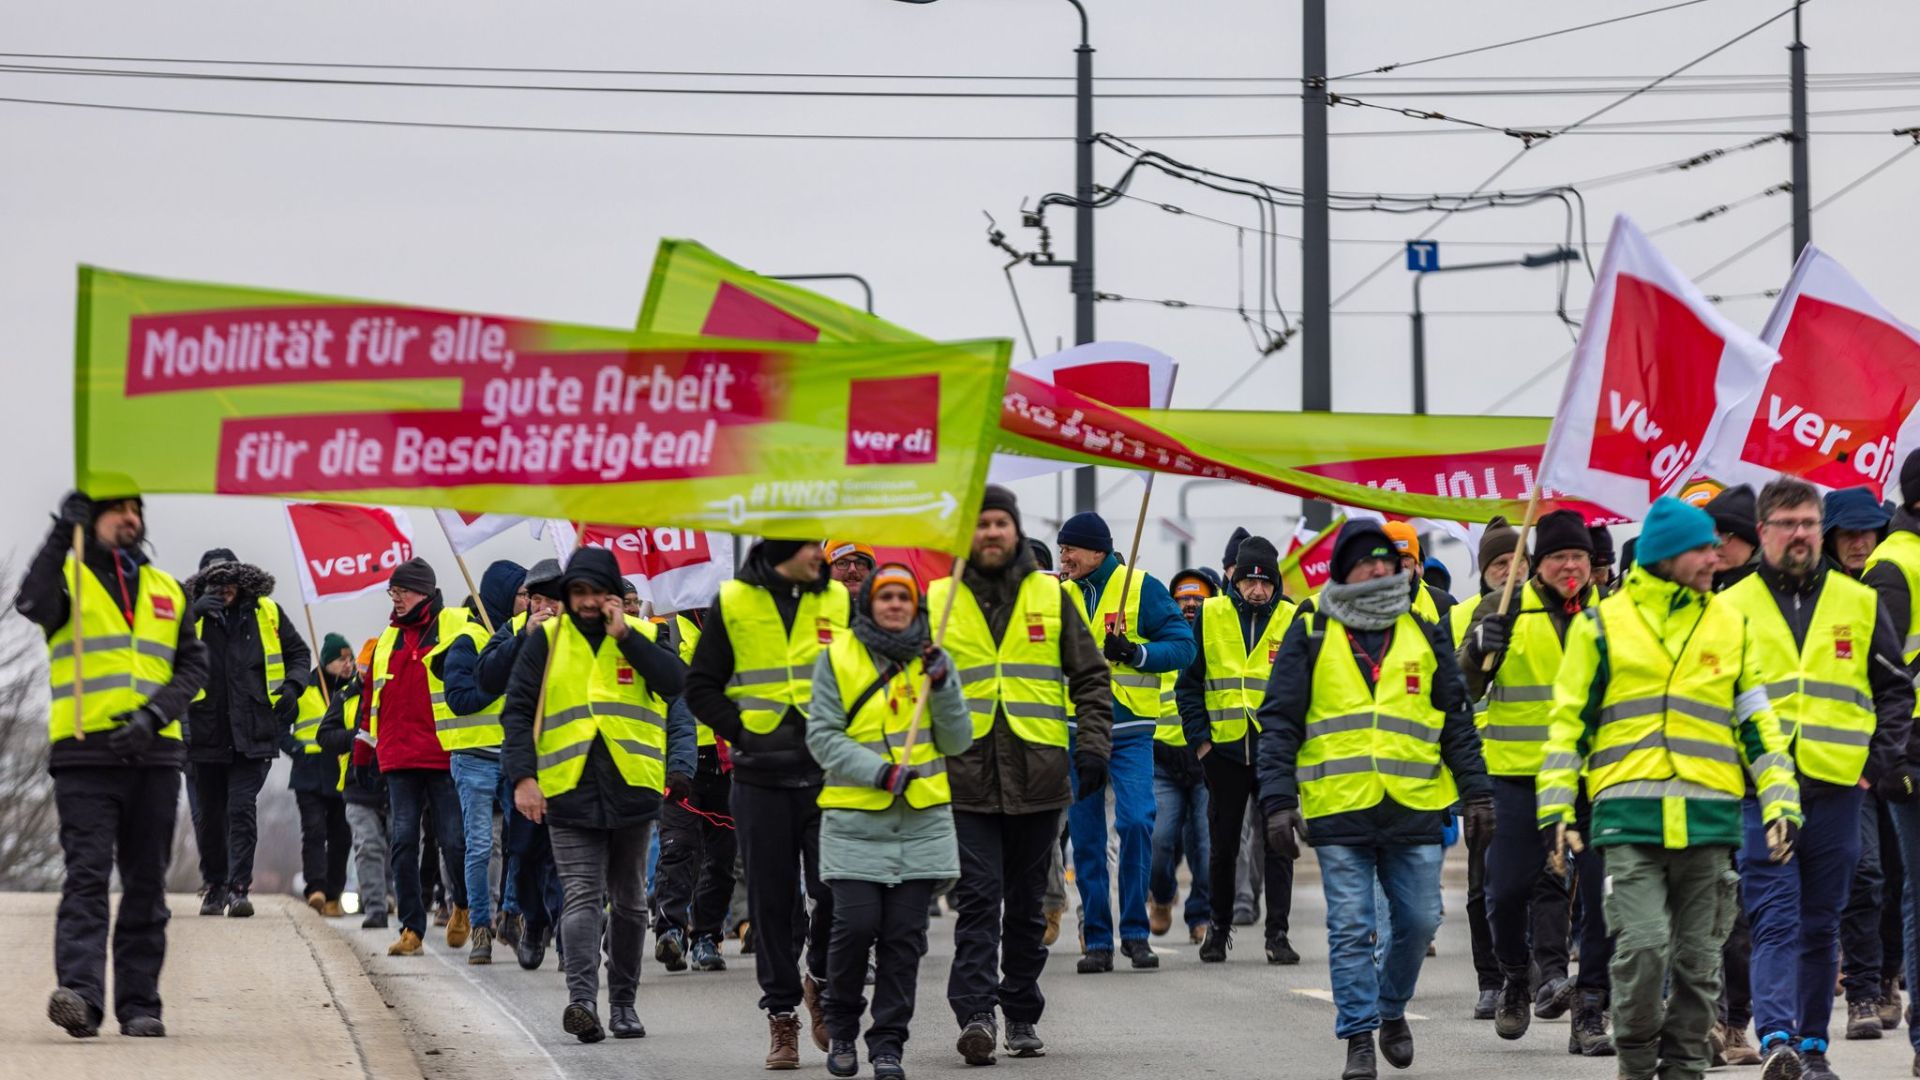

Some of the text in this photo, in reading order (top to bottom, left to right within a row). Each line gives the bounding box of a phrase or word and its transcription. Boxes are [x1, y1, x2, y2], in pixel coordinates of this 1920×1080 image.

[142, 316, 516, 380] Mobilität für alle,
[482, 367, 582, 424] gute
[593, 362, 735, 416] Arbeit
[235, 420, 717, 481] für die Beschäftigten!
[851, 428, 933, 454] ver.di
[1767, 393, 1896, 483] ver.di
[310, 540, 411, 578] ver.di
